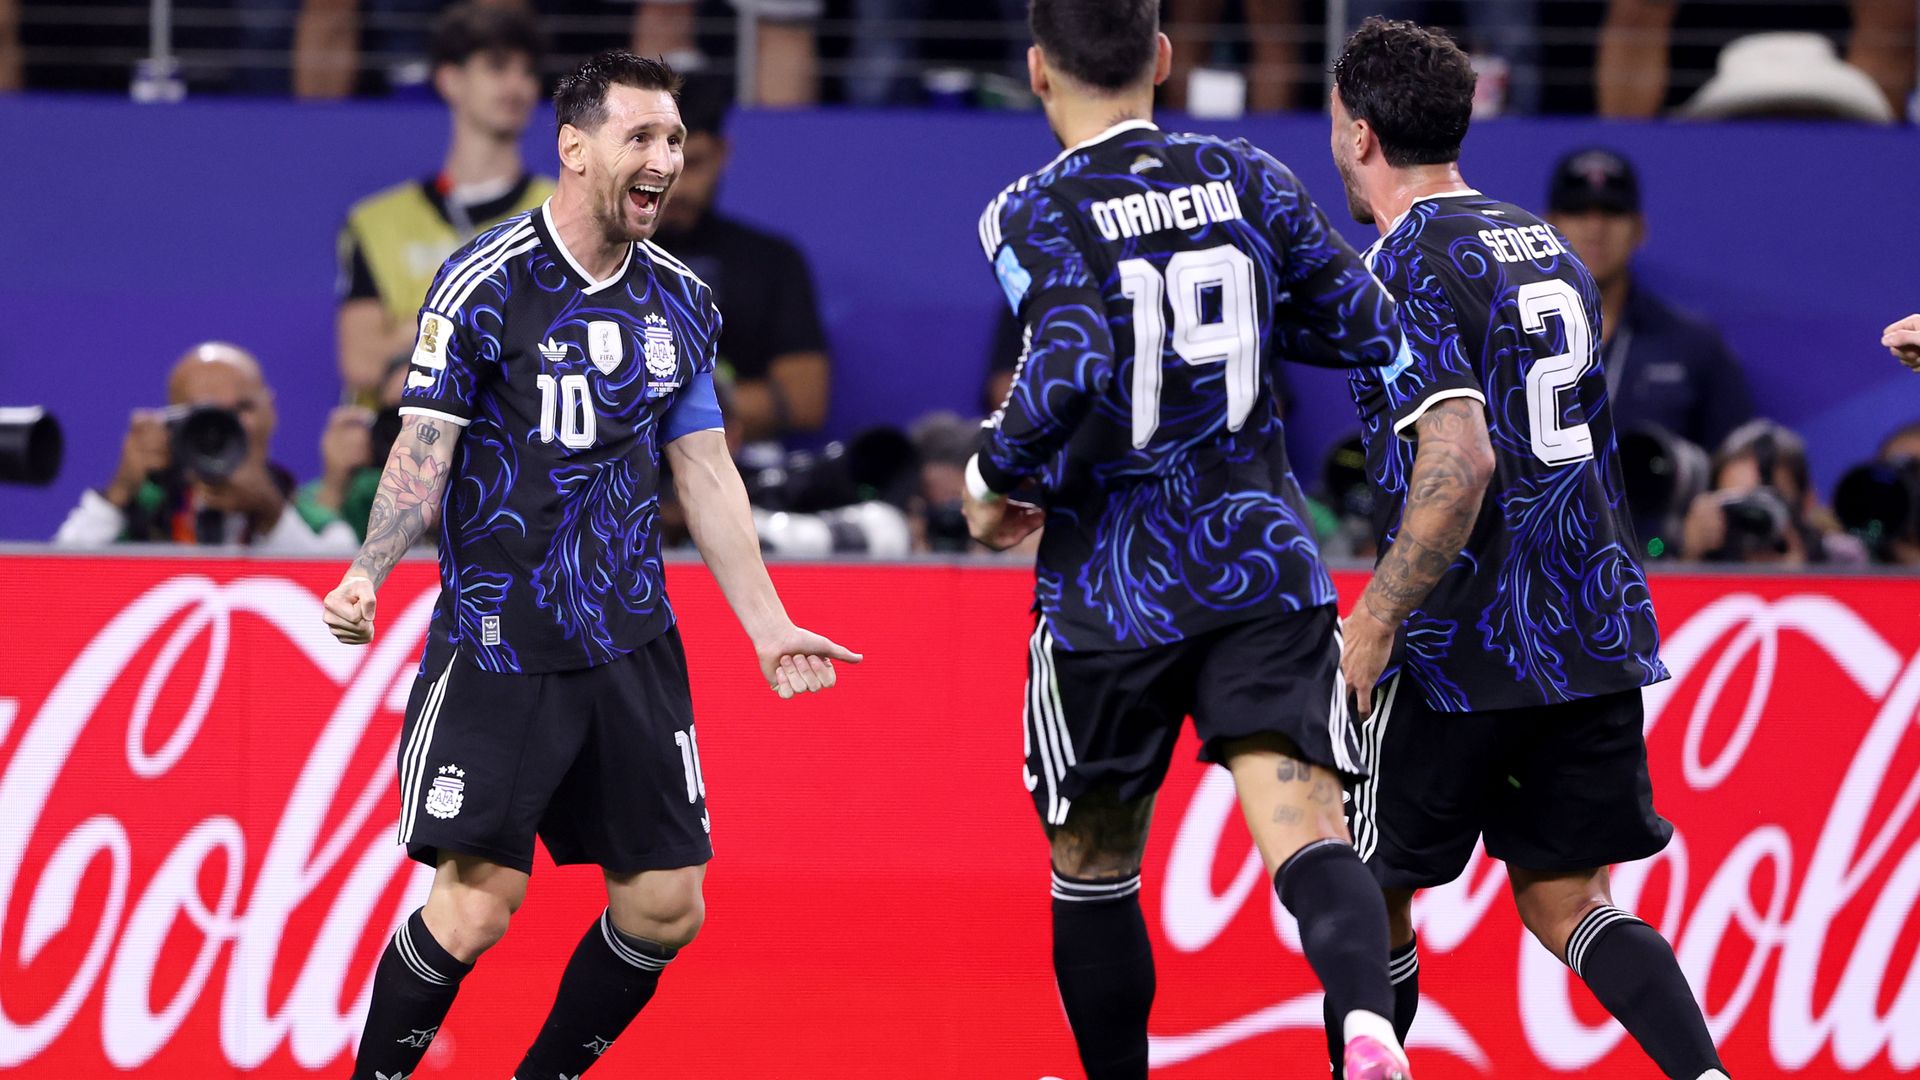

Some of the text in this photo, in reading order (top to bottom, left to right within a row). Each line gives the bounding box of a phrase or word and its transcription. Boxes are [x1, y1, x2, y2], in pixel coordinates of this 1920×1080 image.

[1091, 180, 1243, 241] OTAMENDI
[1478, 223, 1567, 263] SENESI
[1118, 243, 1260, 450] 19
[1518, 278, 1594, 467] 2
[537, 374, 597, 450] 10
